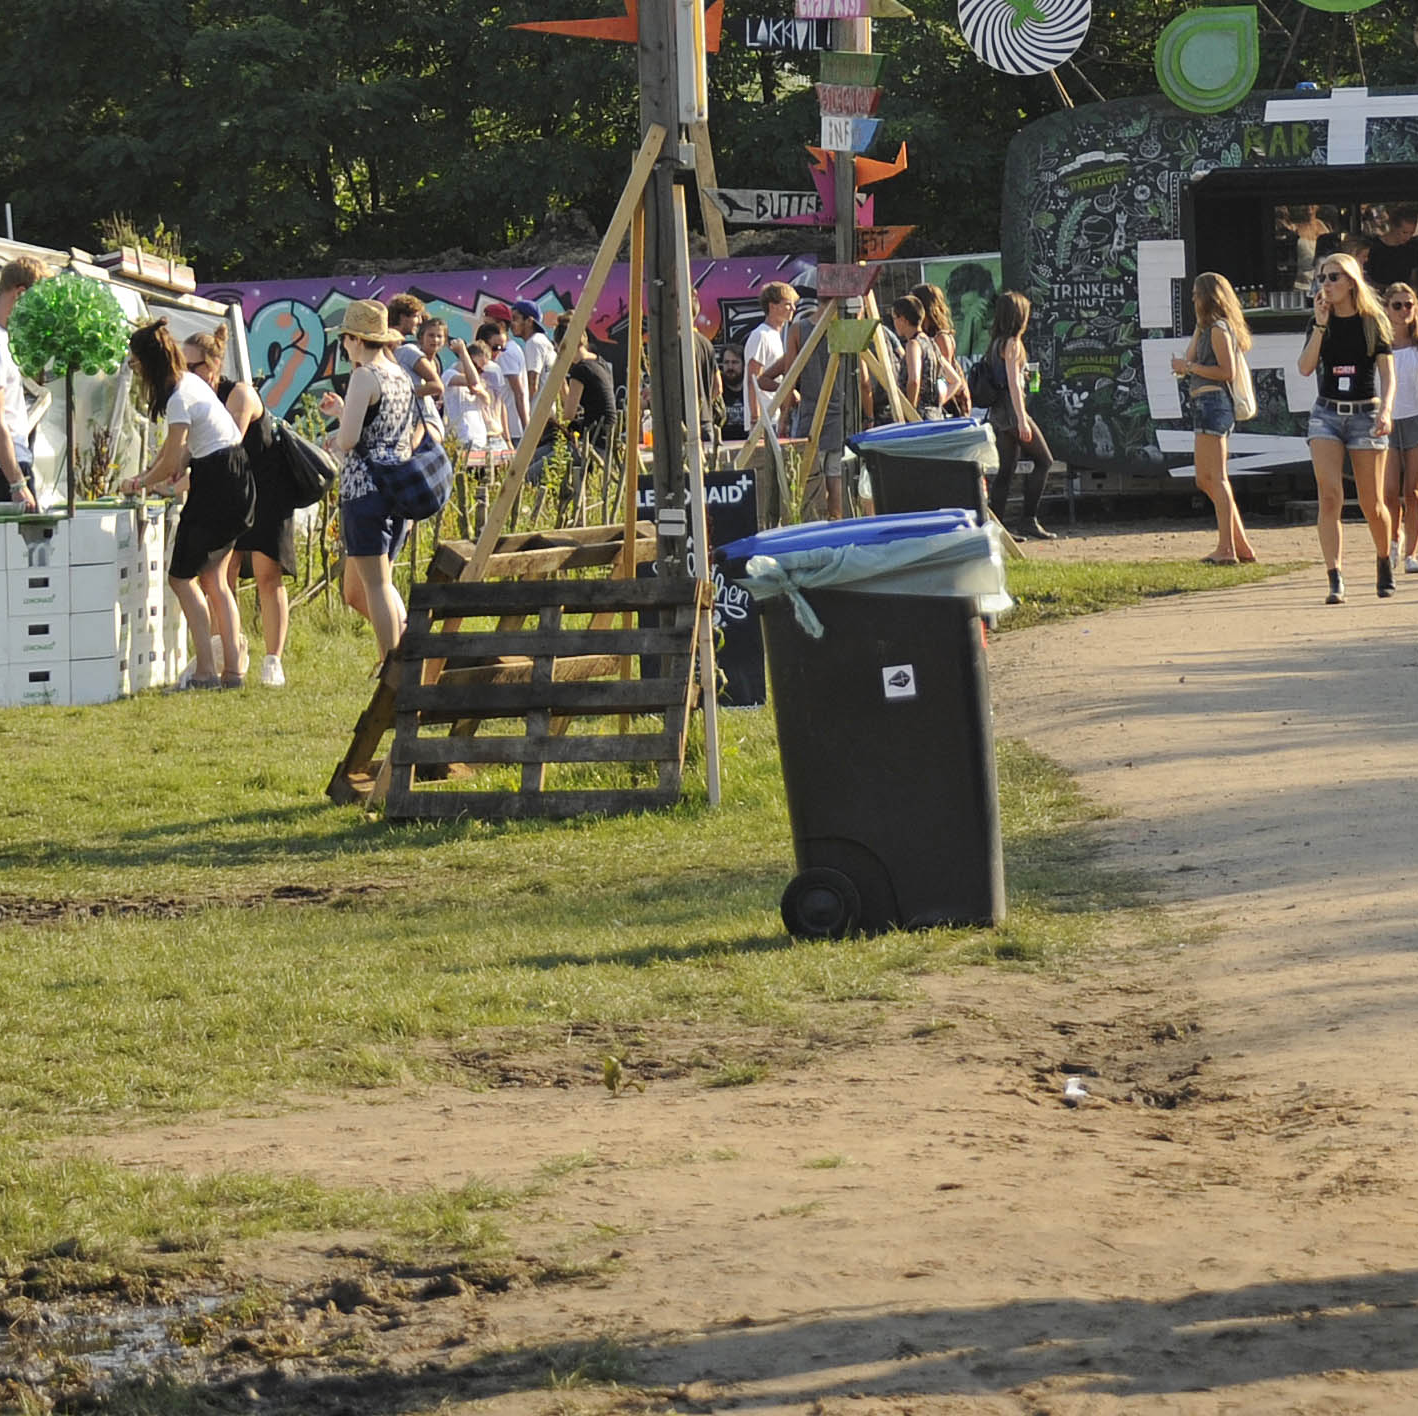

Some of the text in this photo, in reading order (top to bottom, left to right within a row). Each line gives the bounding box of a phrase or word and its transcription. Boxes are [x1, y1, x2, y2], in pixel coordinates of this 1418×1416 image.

[1243, 122, 1311, 161] BAR
[1069, 170, 1127, 193] PARAGUAY
[1049, 283, 1125, 300] TRINKEN
[1073, 296, 1106, 309] HILFT
